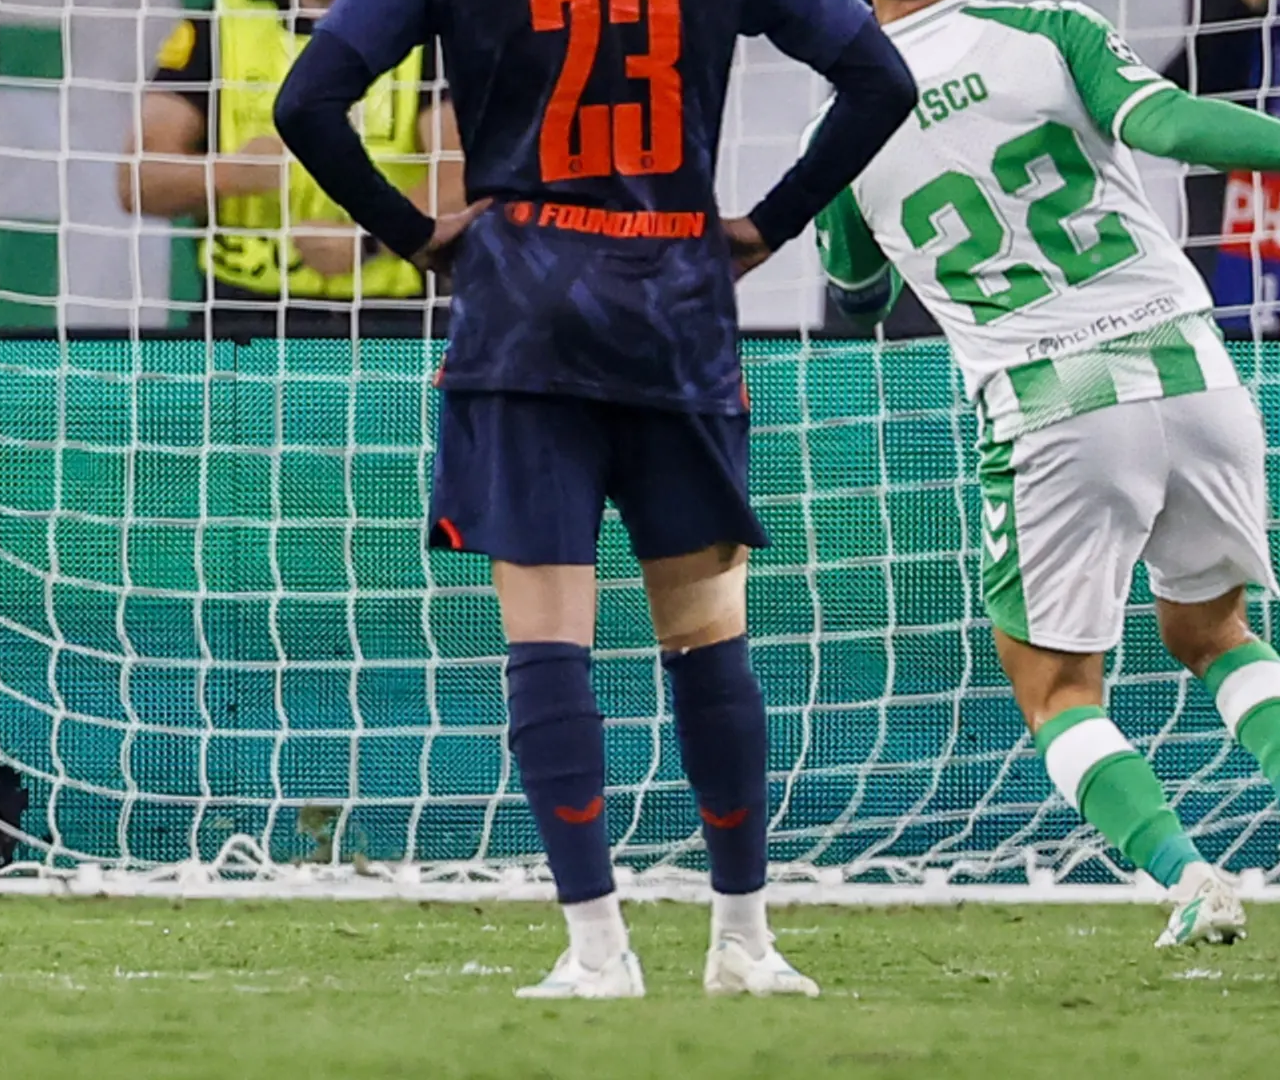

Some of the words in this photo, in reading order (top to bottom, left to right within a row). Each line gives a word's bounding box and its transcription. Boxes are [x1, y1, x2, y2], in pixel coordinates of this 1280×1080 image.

[912, 72, 989, 130] ISCO
[538, 202, 705, 237] FOUNDATION
[900, 120, 1147, 326] 22
